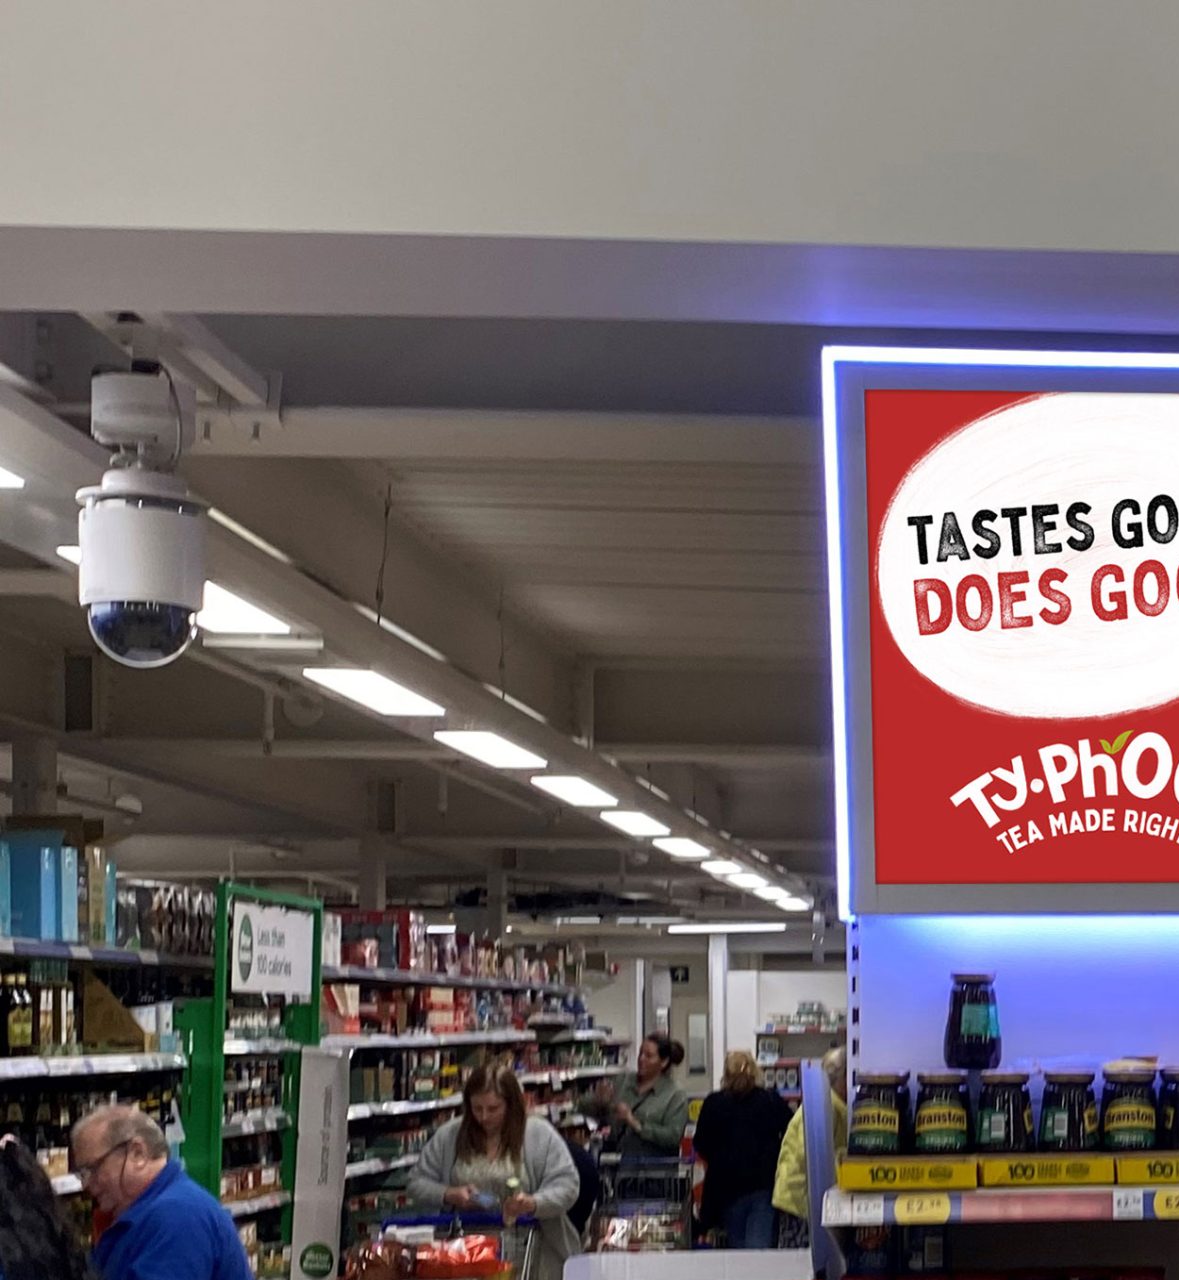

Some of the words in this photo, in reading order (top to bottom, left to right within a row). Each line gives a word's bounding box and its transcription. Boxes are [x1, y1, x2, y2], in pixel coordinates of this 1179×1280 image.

[907, 501, 1095, 565] TASTES
[913, 568, 1072, 636] DOES
[996, 820, 1044, 854] TEA
[1048, 808, 1116, 837] MADE
[257, 954, 268, 975] 100
[869, 1167, 897, 1183] 100
[1008, 1164, 1035, 1180] 100
